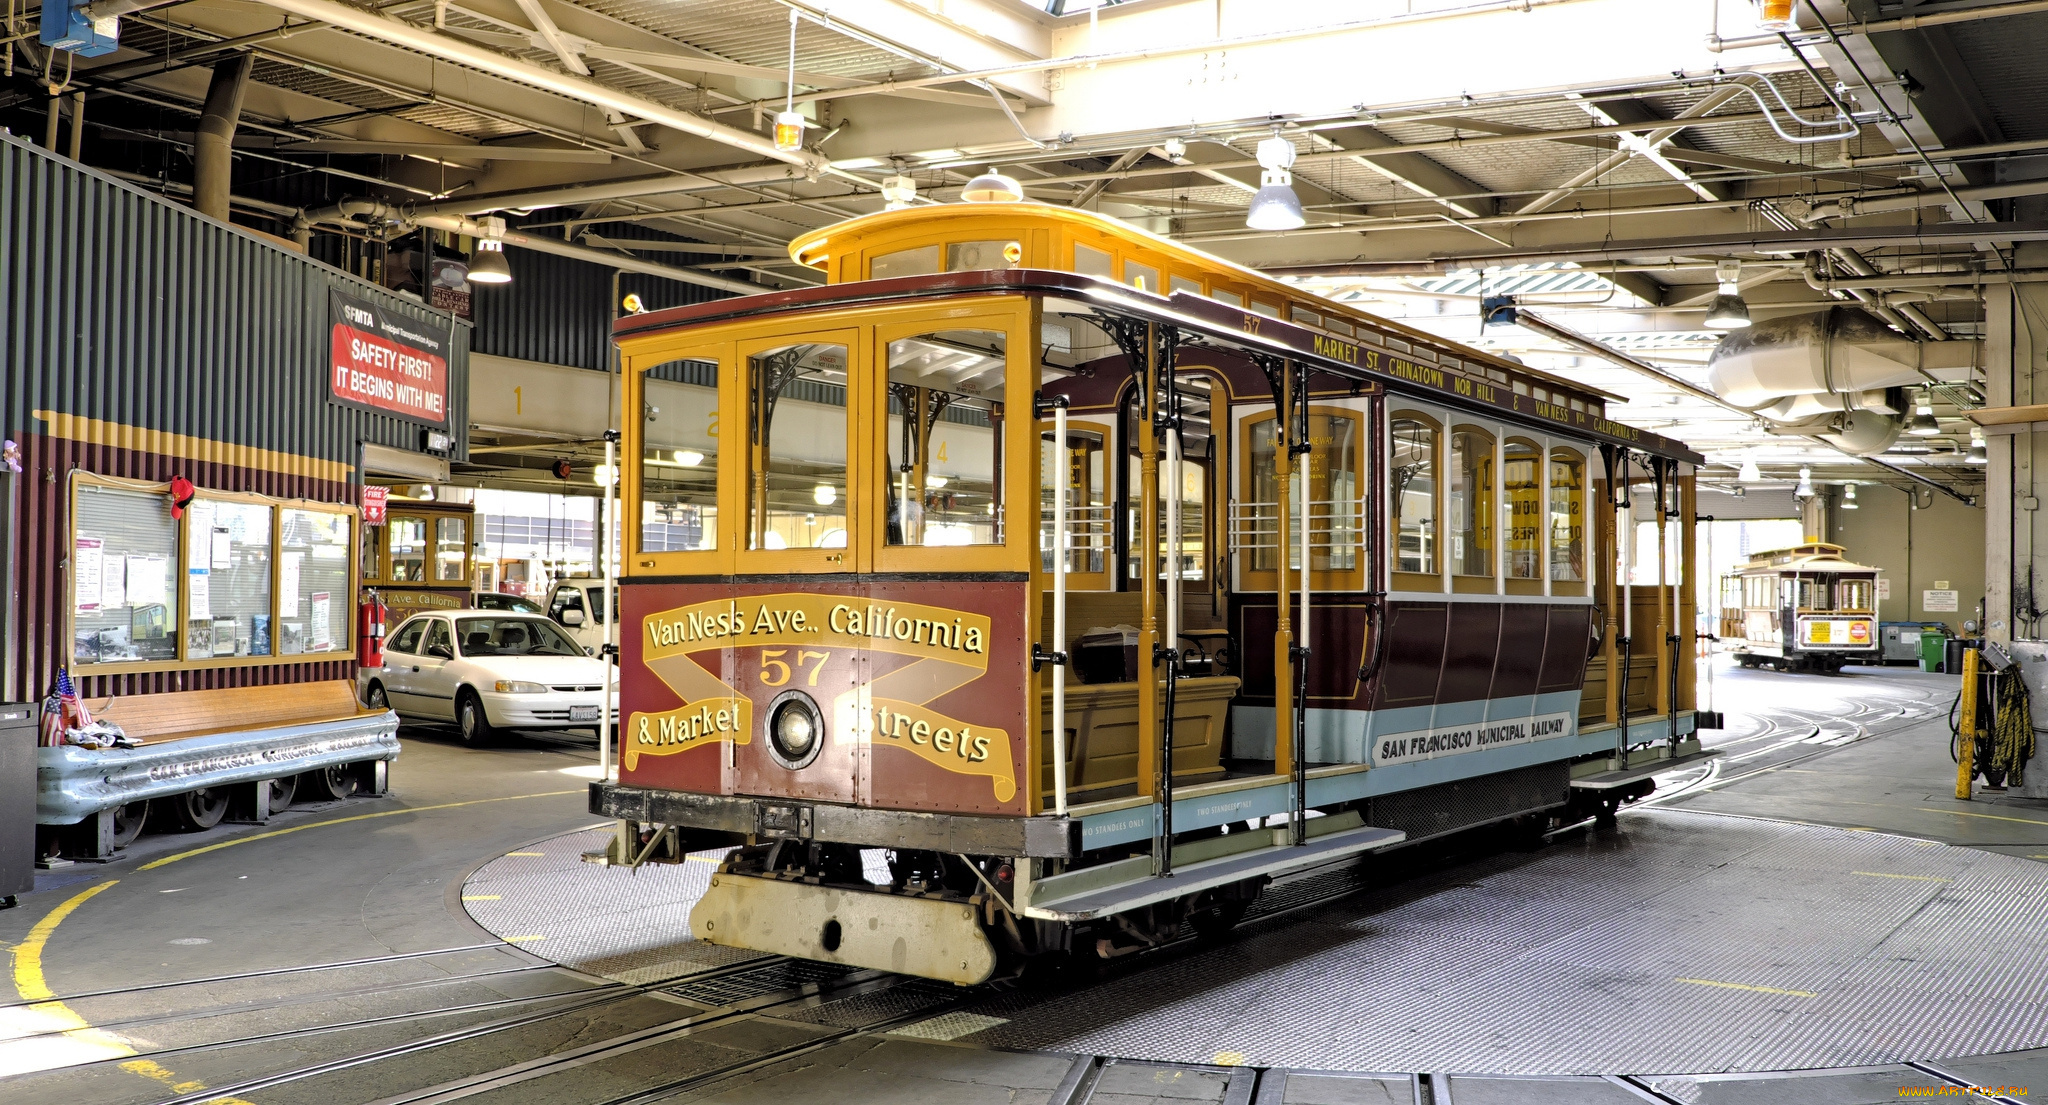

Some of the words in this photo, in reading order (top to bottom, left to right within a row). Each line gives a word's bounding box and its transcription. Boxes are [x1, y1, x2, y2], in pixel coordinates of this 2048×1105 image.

[344, 304, 374, 328] SFMTA
[1243, 313, 1261, 335] 57
[351, 338, 397, 371] SAFETY
[398, 353, 432, 381] FIRST!
[336, 365, 348, 388] IT
[350, 369, 394, 401] BEGINS
[396, 383, 422, 409] WITH
[425, 391, 443, 414] ME!
[513, 385, 522, 415] 1
[1314, 334, 1358, 365] MARKET
[1388, 358, 1444, 389] CHINATOWN
[1454, 376, 1471, 396] NOB
[1476, 384, 1496, 403] HILL
[1535, 400, 1549, 418] VAN
[1550, 403, 1569, 423] NESS
[1593, 417, 1630, 440] CALIFORNIA
[706, 411, 719, 438] 2
[936, 440, 949, 465] 4
[367, 491, 383, 499] FIRE
[418, 594, 461, 608] California
[828, 603, 984, 654] California
[759, 649, 831, 687] 57
[638, 715, 655, 745] &
[656, 703, 740, 747] Market
[1381, 739, 1407, 759] SAN
[1410, 730, 1472, 754] FRANCISCO
[1476, 722, 1526, 745] MUNICIPAL
[1530, 718, 1565, 738] RAILWAY
[150, 765, 179, 781] SAN
[183, 752, 255, 776] FRANCISCO
[262, 743, 323, 763] MUNICIPAL
[329, 734, 378, 752] RAILWAY
[1196, 807, 1210, 817] TWO
[1210, 802, 1236, 815] STANDEES
[1095, 821, 1127, 835] STANDEES
[1128, 818, 1145, 829] ONLY
